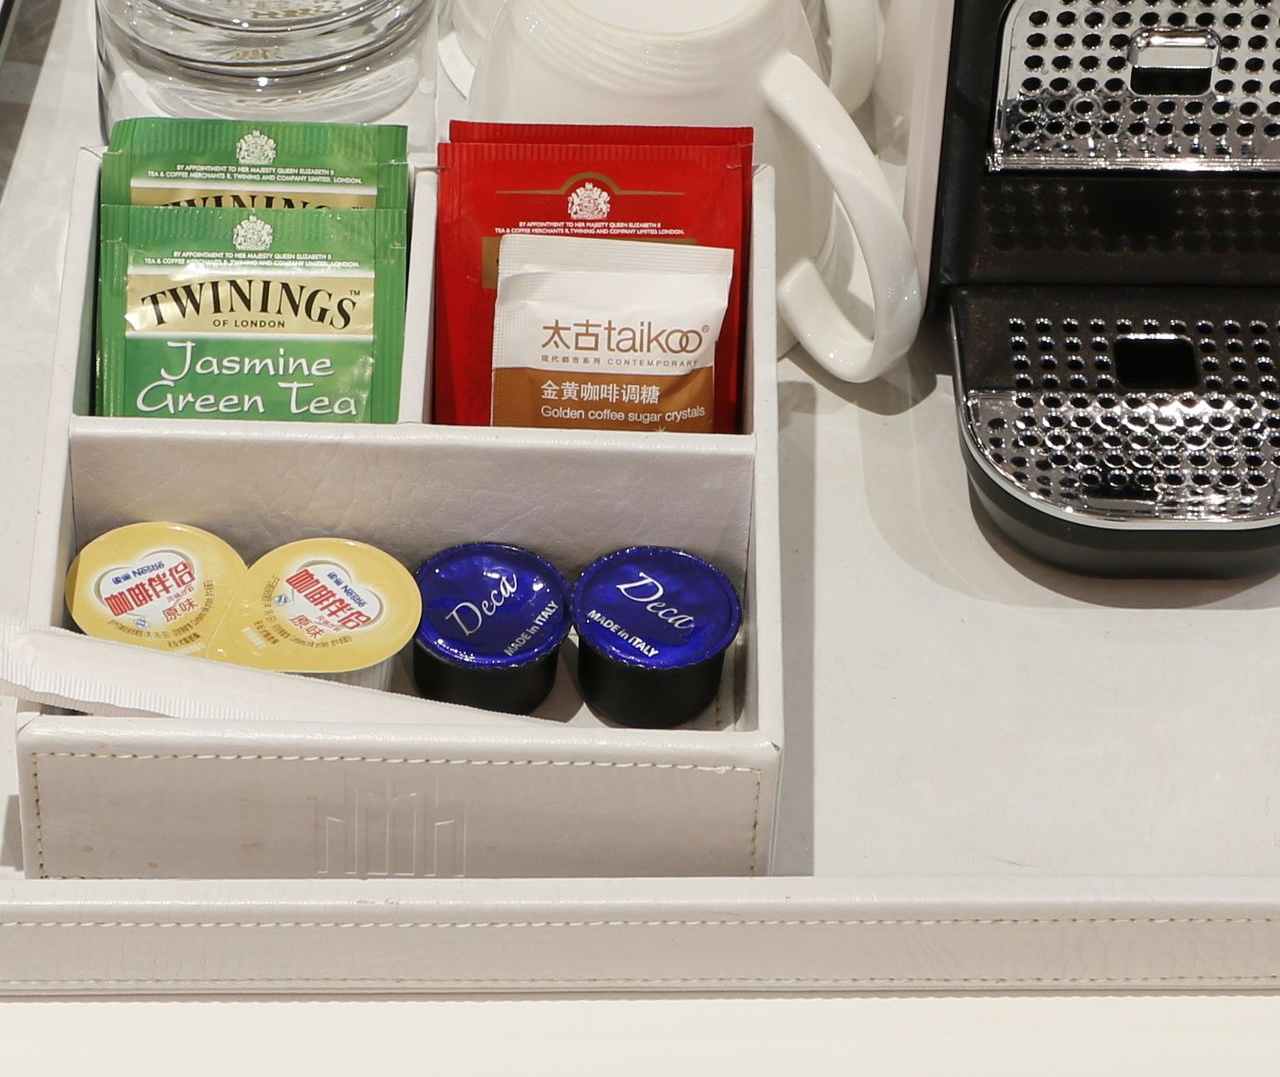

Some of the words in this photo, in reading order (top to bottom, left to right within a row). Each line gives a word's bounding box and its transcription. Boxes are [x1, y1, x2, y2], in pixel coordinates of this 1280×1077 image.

[141, 279, 357, 330] TWININGS
[213, 319, 228, 328] OF
[234, 320, 285, 328] LONDON
[160, 340, 335, 381] Jasmine
[542, 355, 601, 365] 现代都市系列
[608, 358, 699, 368] CONTEMPORARY
[136, 380, 265, 414] Green
[277, 381, 358, 416] Tea
[541, 380, 661, 405] 金黄咖啡调糖
[541, 405, 585, 420] Golden
[588, 408, 625, 421] coffee
[628, 411, 662, 424] sugar
[664, 406, 706, 422] crystals
[104, 560, 196, 617] 咖啡伴侣
[285, 568, 374, 630] 咖啡伴侣
[445, 573, 518, 637] Deca
[616, 572, 696, 630] Deca
[162, 598, 198, 623] 原味
[290, 614, 326, 640] 原味
[504, 630, 531, 656] MADE
[528, 623, 540, 635] in
[536, 600, 560, 628] ITALY
[587, 608, 620, 634] MADE
[618, 629, 630, 640] in
[628, 634, 661, 658] ITALY
